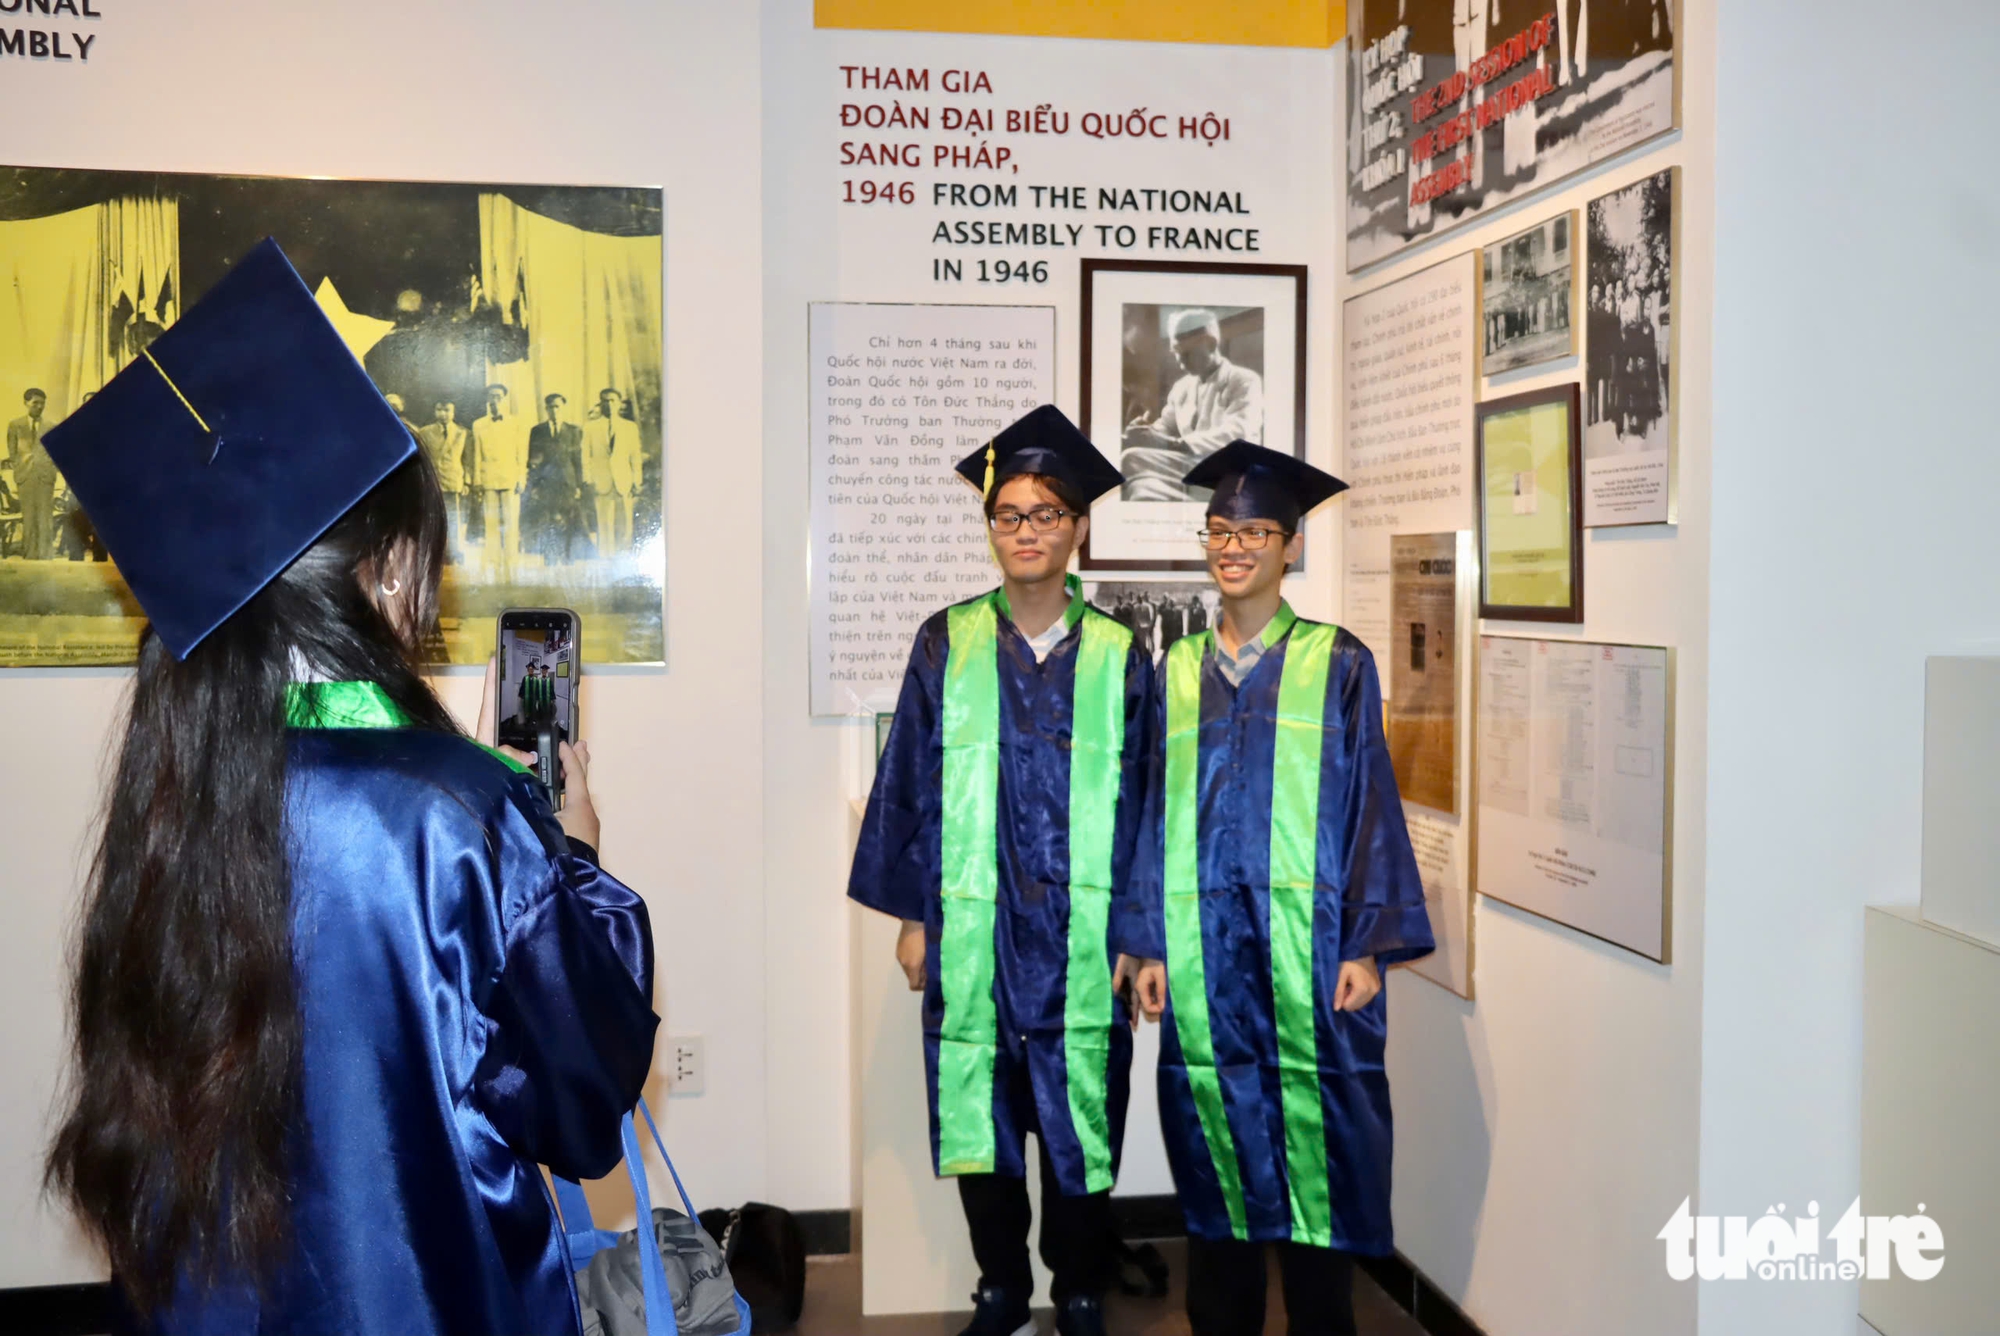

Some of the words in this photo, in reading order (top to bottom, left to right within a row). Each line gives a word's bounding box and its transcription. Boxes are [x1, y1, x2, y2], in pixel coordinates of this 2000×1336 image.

[0, 28, 96, 60] MBLY
[1410, 87, 1438, 124] THE
[1437, 71, 1466, 107] 2ND
[1468, 29, 1528, 90] SESSION
[1530, 13, 1555, 52] OF
[840, 66, 929, 92] THAM
[941, 70, 993, 94] GIA
[1410, 130, 1438, 165] THE
[1437, 108, 1474, 151] FIRST
[1476, 63, 1554, 130] NATIONAL
[840, 100, 929, 130] ĐOÀN
[941, 106, 994, 137] ĐẠI
[1006, 104, 1070, 135] BIỂU
[1081, 108, 1168, 139] QUỐC
[1178, 113, 1231, 147] HỘI
[840, 142, 921, 168] SANG
[934, 141, 1019, 174] PHÁP,
[1410, 152, 1474, 207] ASSEMBLY
[841, 180, 916, 204] 1946
[933, 183, 1017, 209] FROM
[1029, 186, 1088, 210] THE
[1098, 187, 1250, 215] NATIONAL
[932, 221, 1083, 247] ASSEMBLY
[1094, 225, 1136, 248] TO
[1147, 227, 1260, 252] FRANCE
[933, 259, 962, 281] IN
[976, 260, 1049, 283] 1946
[869, 336, 890, 348] Chỉ
[898, 337, 922, 348] hơn
[930, 338, 937, 348] 4
[946, 337, 981, 352] tháng
[989, 341, 1010, 349] sau
[1018, 338, 1037, 349] khi
[827, 354, 860, 369] Quốc
[867, 356, 886, 369] hội
[892, 357, 924, 368] nước
[930, 357, 954, 370] Việt
[960, 358, 988, 369] Nam
[995, 361, 1006, 369] ra
[827, 375, 861, 387] Đoàn
[869, 375, 900, 388] Quốc
[909, 376, 928, 389] hội
[937, 375, 964, 390] gồm
[974, 377, 988, 388] 10
[828, 397, 862, 409] trong
[869, 395, 885, 406] đó
[892, 396, 906, 406] có
[913, 396, 937, 407] Tôn
[944, 396, 968, 407] Đức
[975, 395, 1014, 411] Thắng
[1021, 397, 1037, 408] do
[828, 415, 851, 426] Phó
[862, 415, 908, 429] Trưởng
[919, 416, 942, 426] ban
[952, 416, 1001, 429] Thường
[828, 434, 862, 447] Phạm
[875, 435, 898, 445] Văn
[910, 433, 944, 448] Đồng
[956, 435, 979, 446] làm
[828, 454, 859, 465] đoàn
[870, 456, 899, 468] sang
[909, 454, 941, 466] thăm
[828, 472, 873, 486] chuyến
[878, 474, 908, 487] công
[914, 475, 931, 485] tác
[828, 493, 852, 504] tiên
[857, 494, 878, 504] của
[883, 493, 915, 506] Quốc
[920, 494, 939, 506] hội
[944, 494, 967, 506] Việt
[870, 513, 886, 524] 20
[897, 513, 926, 527] ngày
[937, 513, 952, 526] tại
[962, 512, 985, 524] Phá
[828, 533, 843, 543] đã
[850, 531, 873, 546] tiếp
[880, 533, 900, 543] xúc
[907, 533, 926, 543] với
[931, 533, 951, 543] các
[828, 552, 859, 563] đoàn
[867, 550, 890, 564] thể,
[898, 552, 927, 563] nhân
[935, 552, 957, 563] dân
[829, 569, 855, 583] hiểu
[865, 572, 877, 583] rõ
[886, 572, 914, 585] cuộc
[924, 570, 946, 582] đấu
[956, 572, 988, 582] tranh
[829, 591, 847, 606] lập
[853, 591, 874, 602] của
[880, 591, 903, 604] Việt
[909, 592, 937, 602] Nam
[943, 591, 956, 602] và
[829, 613, 860, 626] quan
[871, 611, 885, 623] hệ
[829, 630, 861, 643] thiện
[867, 631, 891, 642] trên
[829, 650, 835, 664] ý
[840, 652, 885, 664] nguyện
[890, 648, 903, 660] về
[830, 668, 856, 680] nhất
[862, 669, 883, 680] của
[888, 669, 905, 680] Việ
